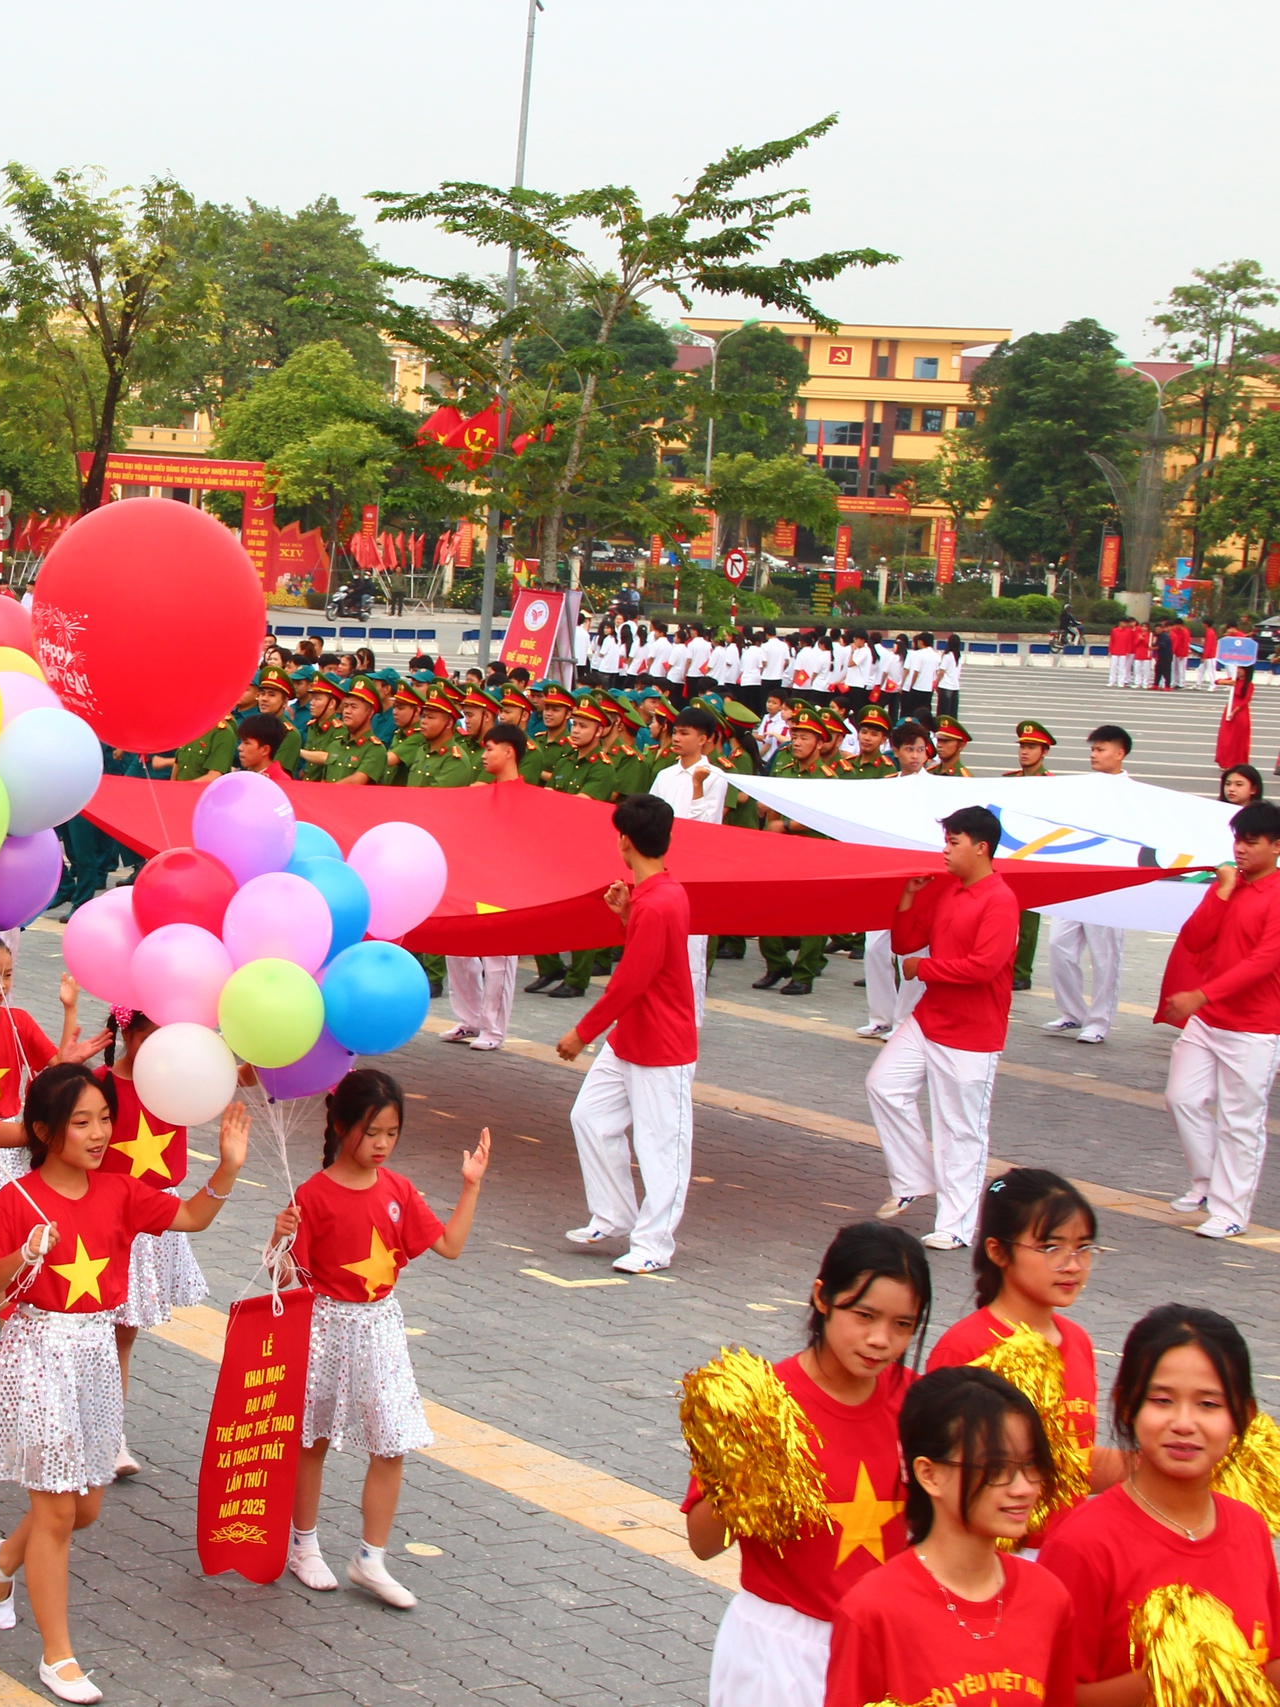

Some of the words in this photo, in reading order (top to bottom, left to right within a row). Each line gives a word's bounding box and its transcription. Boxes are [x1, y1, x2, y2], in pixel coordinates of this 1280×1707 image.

[279, 549, 304, 557] XIV
[39, 638, 73, 667] Happy
[244, 1367, 265, 1389] KHAI
[266, 1364, 286, 1386] MẠC
[245, 1398, 260, 1417] ĐẠI
[261, 1391, 277, 1414] HỘI
[235, 1424, 252, 1445] DỤC
[271, 1415, 295, 1433] THAO
[217, 1449, 232, 1468] XÃ
[233, 1445, 259, 1469] THẠCH
[261, 1436, 284, 1461] THẤT
[225, 1469, 241, 1493] LẦN
[244, 1470, 261, 1489] THỨ
[263, 1470, 267, 1487] I
[219, 1498, 239, 1518] NĂM
[242, 1498, 266, 1516] 2025
[952, 1672, 988, 1698] YÊU
[987, 1668, 1023, 1692] VIỆT
